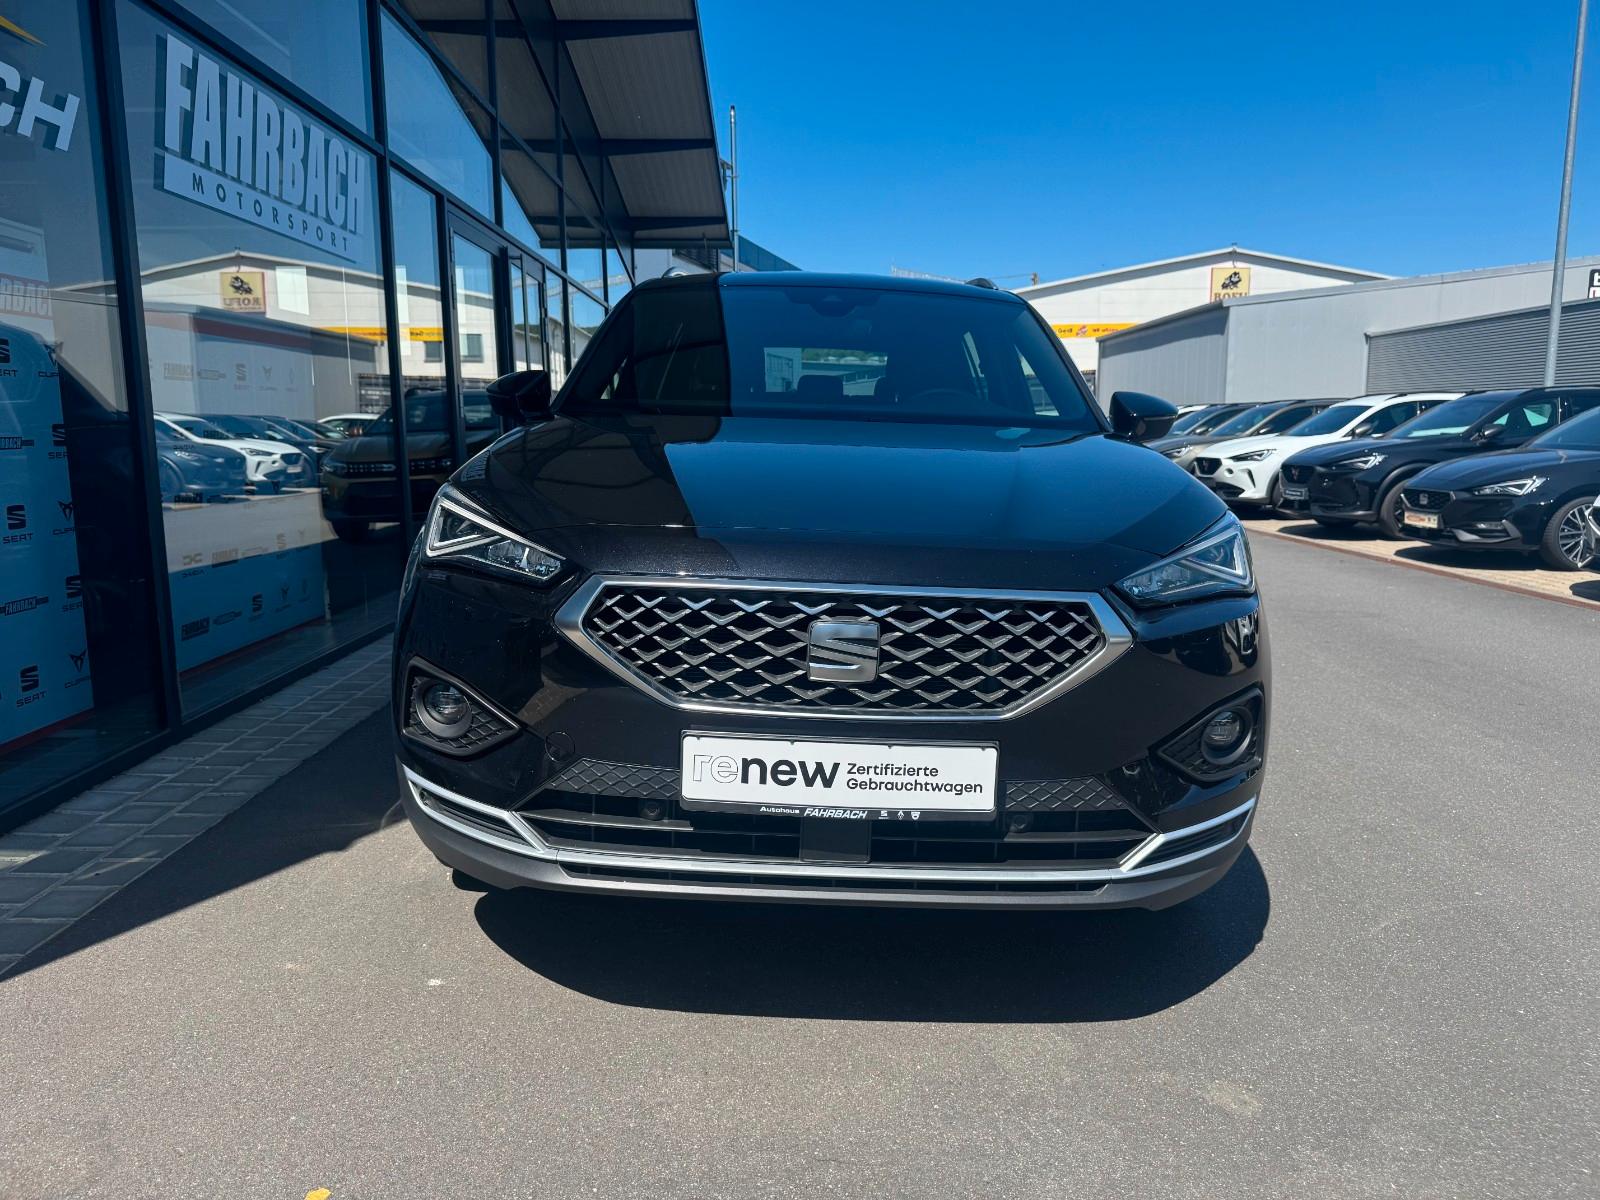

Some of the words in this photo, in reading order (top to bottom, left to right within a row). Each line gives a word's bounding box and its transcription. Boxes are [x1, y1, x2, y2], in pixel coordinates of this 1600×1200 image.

[165, 33, 365, 233] FAHRBACH
[191, 172, 351, 251] MOTORSPORT
[2, 533, 33, 544] SEAT
[16, 690, 47, 708] SEAT
[692, 754, 841, 789] renew
[846, 763, 939, 777] Zertifizierte
[846, 778, 983, 795] Gebrauchtwagen
[759, 806, 800, 814] Autohaus
[804, 808, 868, 819] FAHRBACH
